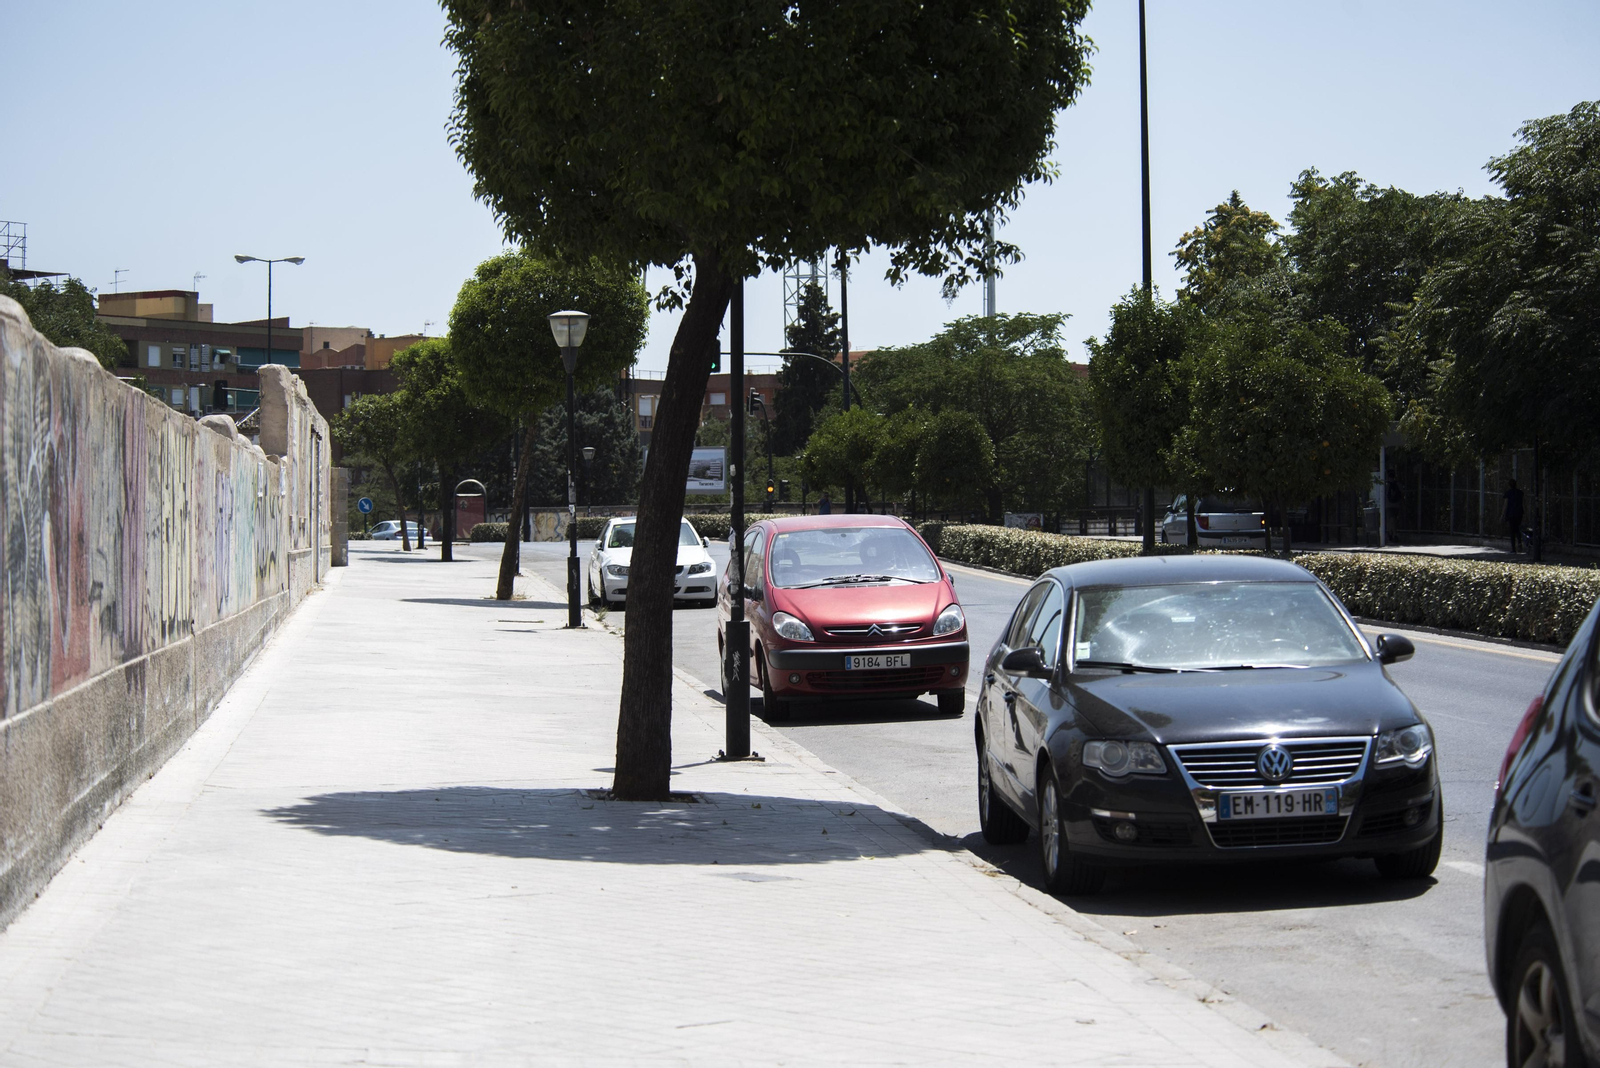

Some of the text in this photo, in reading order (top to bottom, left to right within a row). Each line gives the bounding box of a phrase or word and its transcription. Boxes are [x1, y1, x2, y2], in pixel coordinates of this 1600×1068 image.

[853, 656, 907, 668] 9184 BFL
[1232, 793, 1323, 815] EM-119-HR
